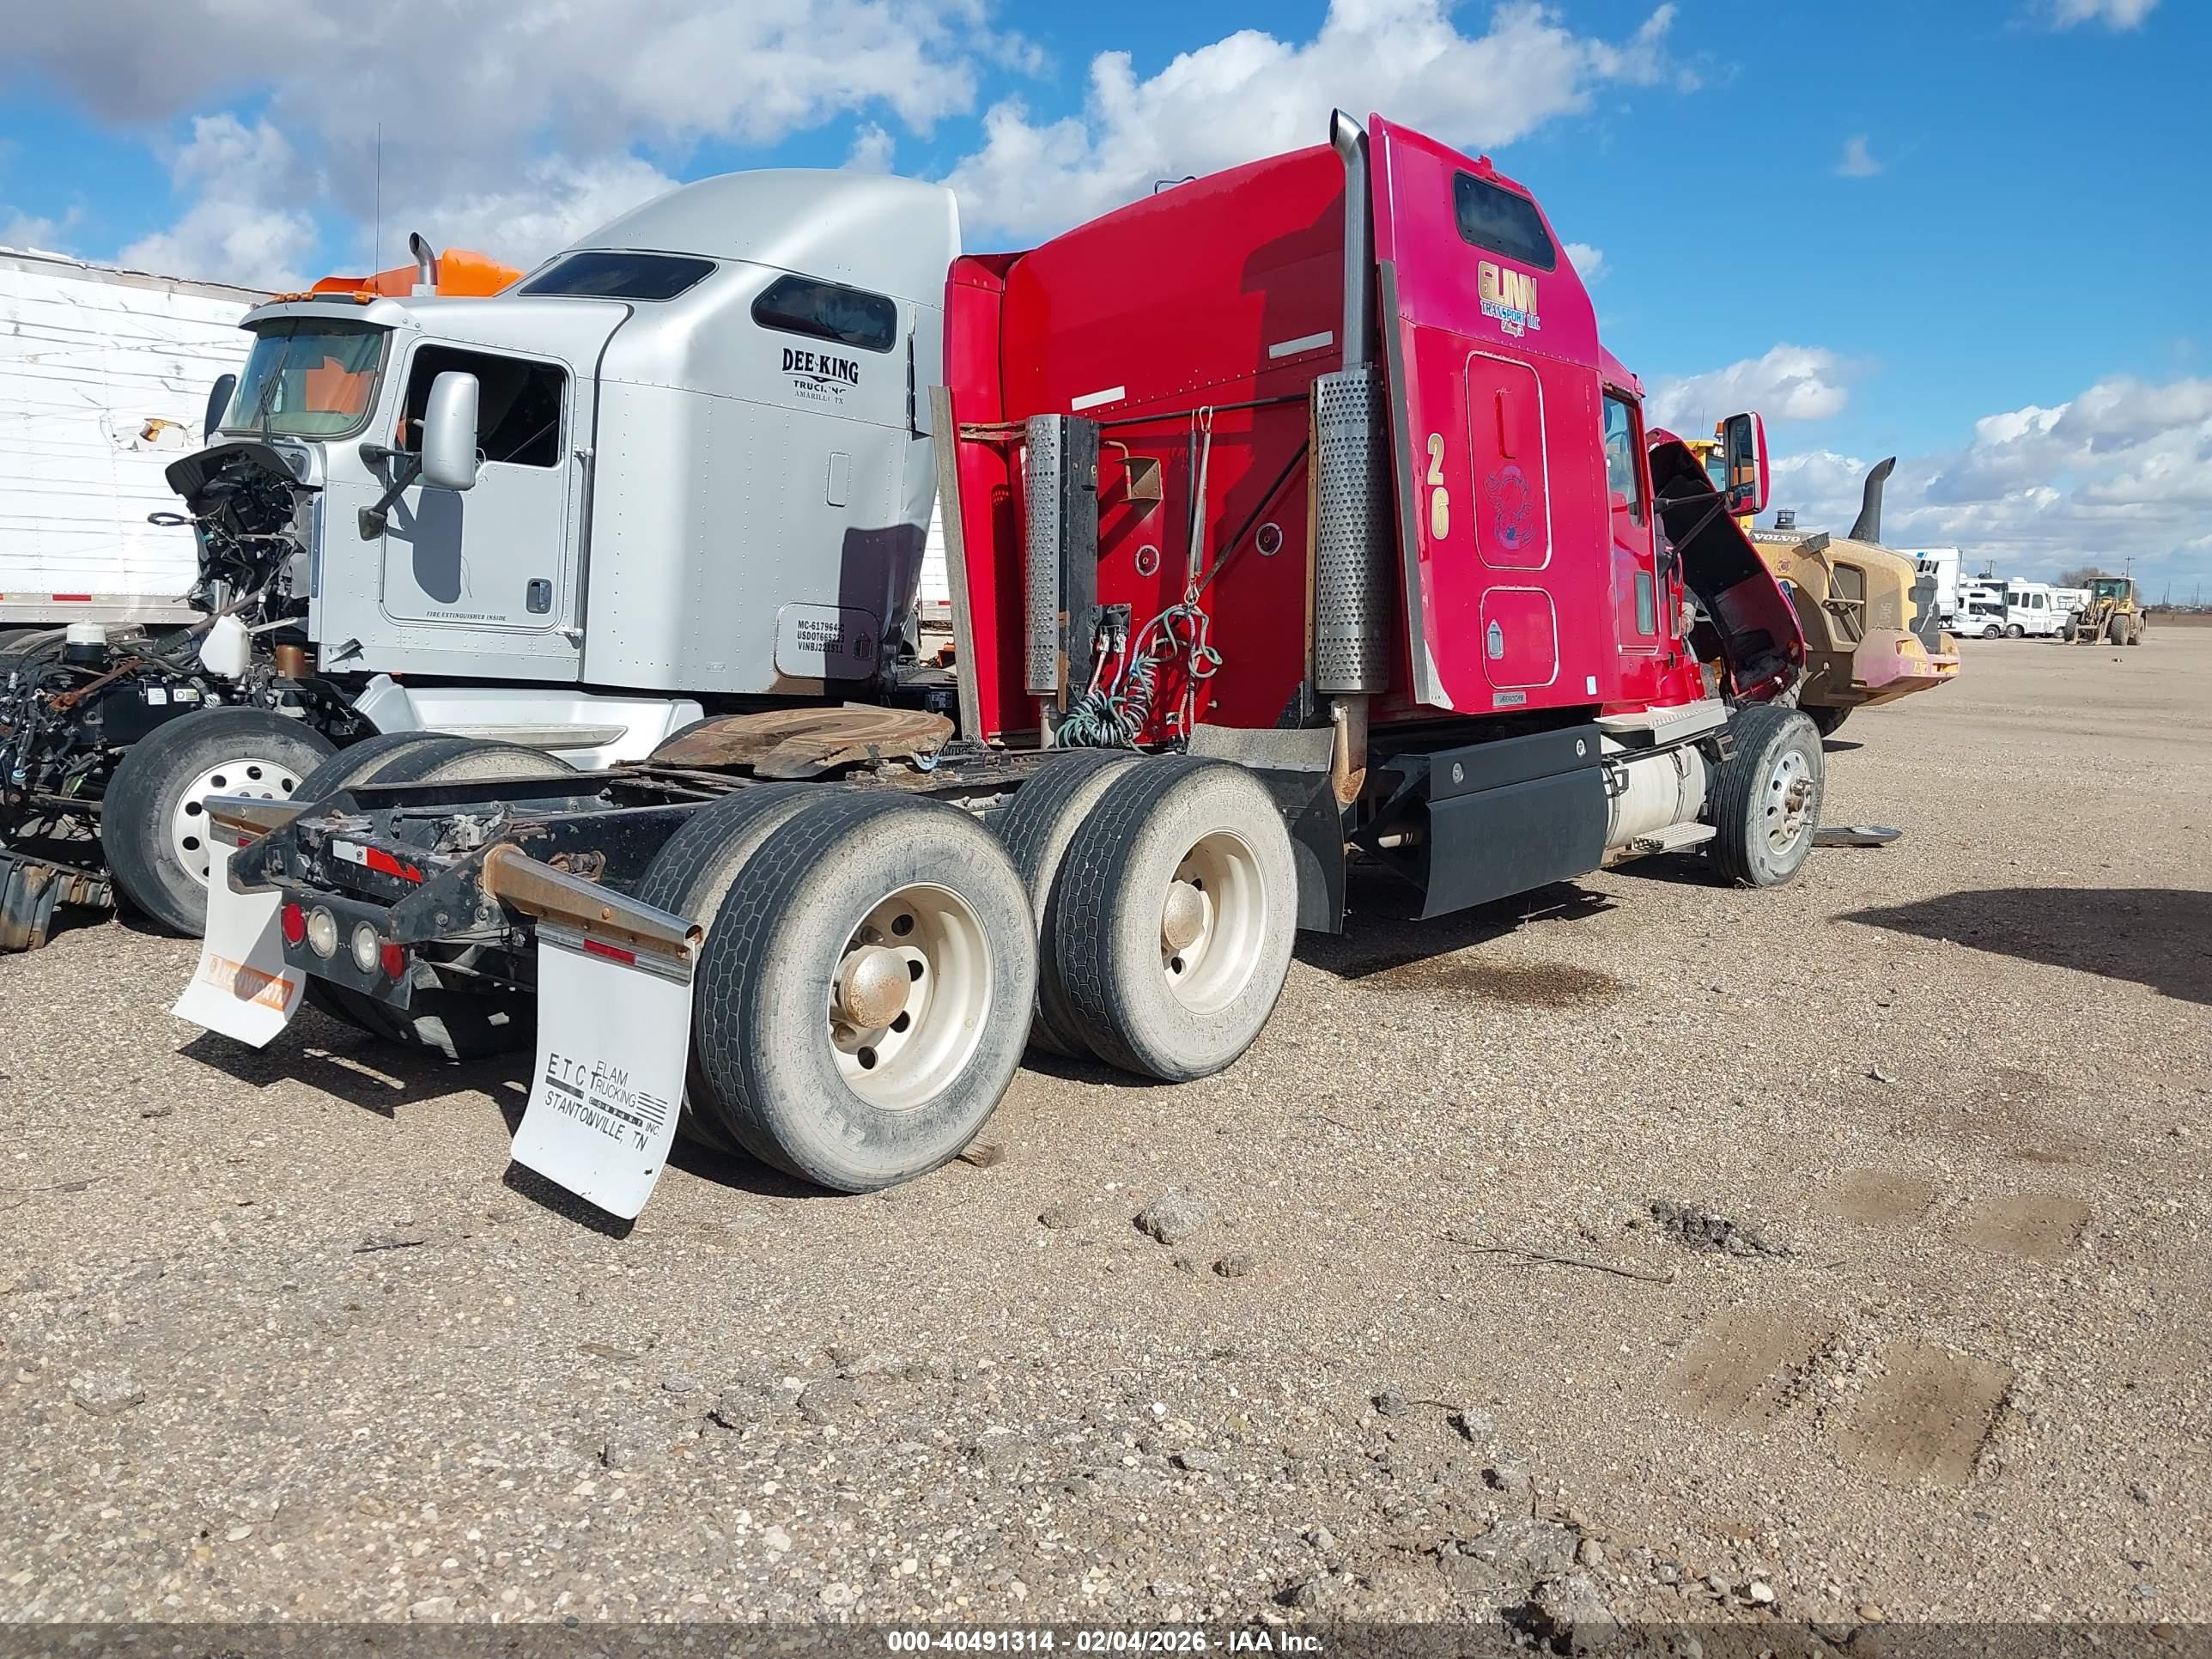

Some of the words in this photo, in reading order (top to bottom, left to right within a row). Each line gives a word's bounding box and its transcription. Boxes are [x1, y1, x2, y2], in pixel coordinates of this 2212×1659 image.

[1480, 301, 1526, 326] TRANSPORT
[1753, 533, 1801, 543] VOLVO
[596, 1060, 629, 1088] ELAM
[632, 1129, 649, 1152] TN
[645, 1121, 660, 1138] INC.
